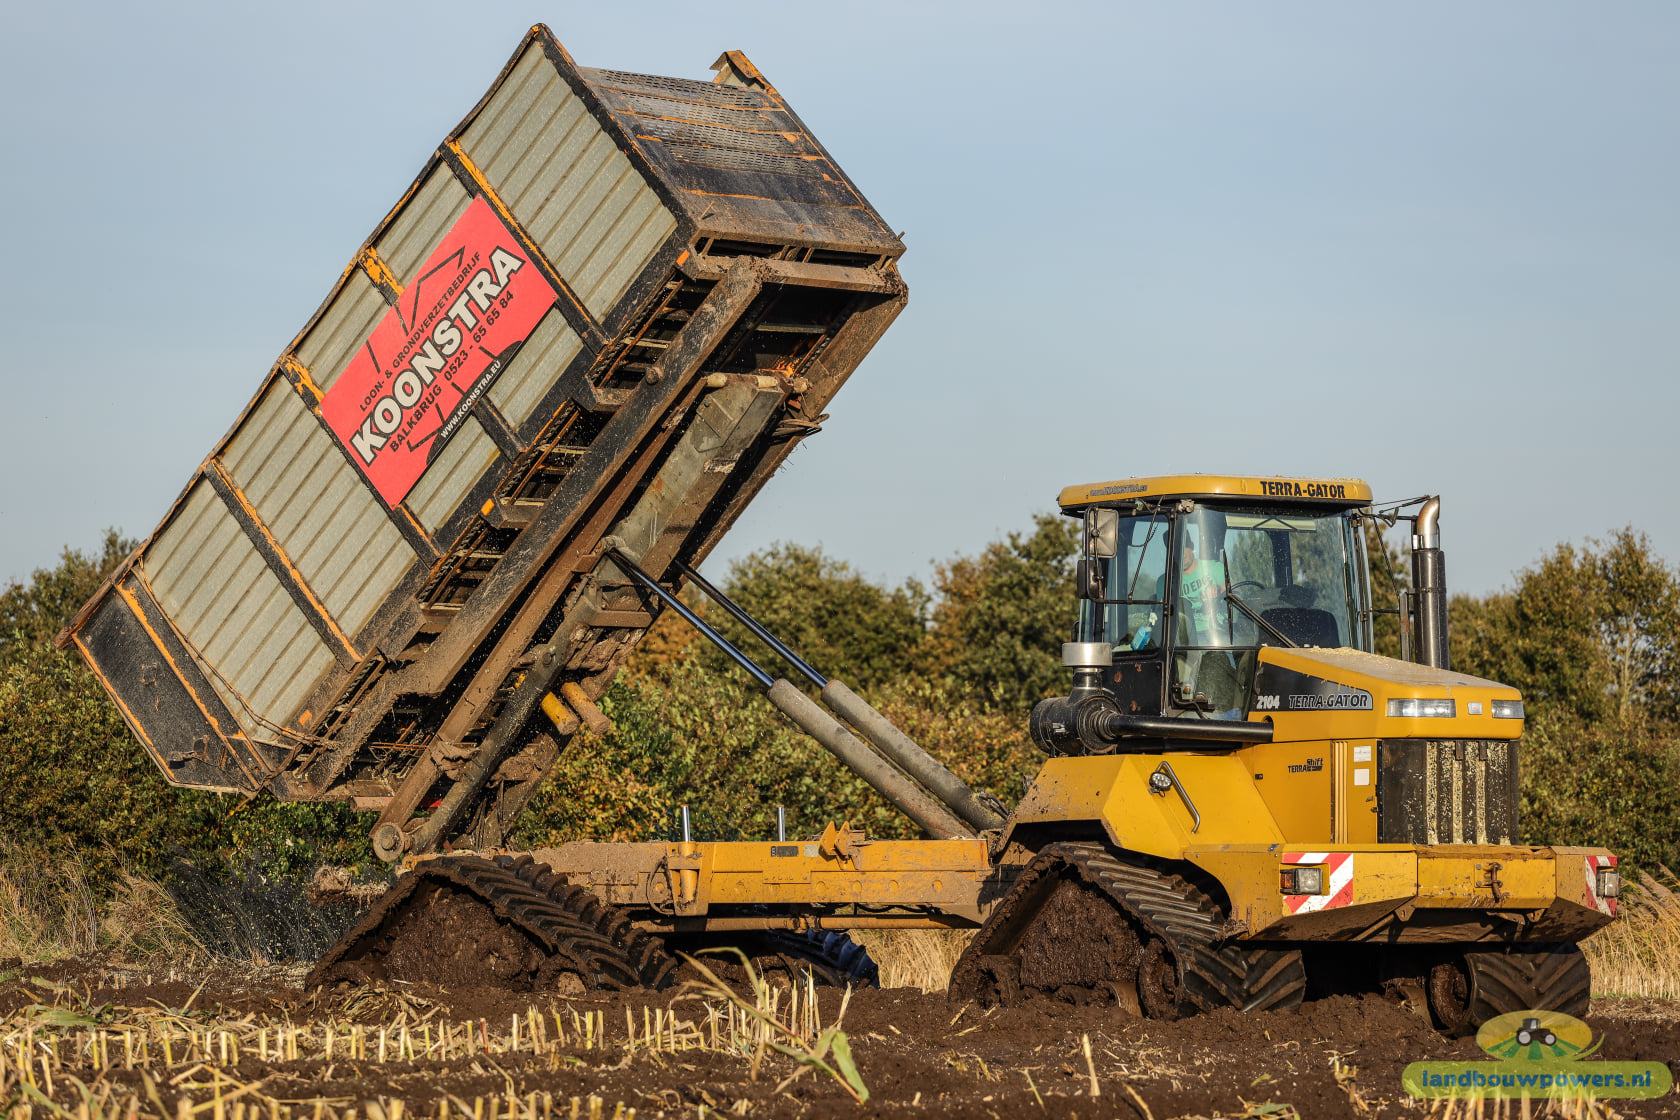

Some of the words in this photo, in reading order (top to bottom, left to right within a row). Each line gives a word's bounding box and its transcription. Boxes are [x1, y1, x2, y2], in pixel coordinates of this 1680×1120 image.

[359, 379, 385, 411] LOON-
[385, 369, 393, 380] &
[392, 252, 482, 368] GRONDVERZETBEDRIJF
[350, 245, 526, 467] KOONSTRA
[390, 385, 442, 453] BALKBRUG
[444, 350, 469, 382] 0523
[472, 325, 488, 344] 65
[485, 308, 501, 327] 65
[499, 290, 514, 308] 84
[440, 360, 501, 438] WWW.KOONSTRA.EU
[1260, 480, 1345, 499] TERRA-GATOR
[1256, 694, 1280, 710] 2104
[1288, 764, 1307, 773] TERRA
[1306, 757, 1323, 766] Shift
